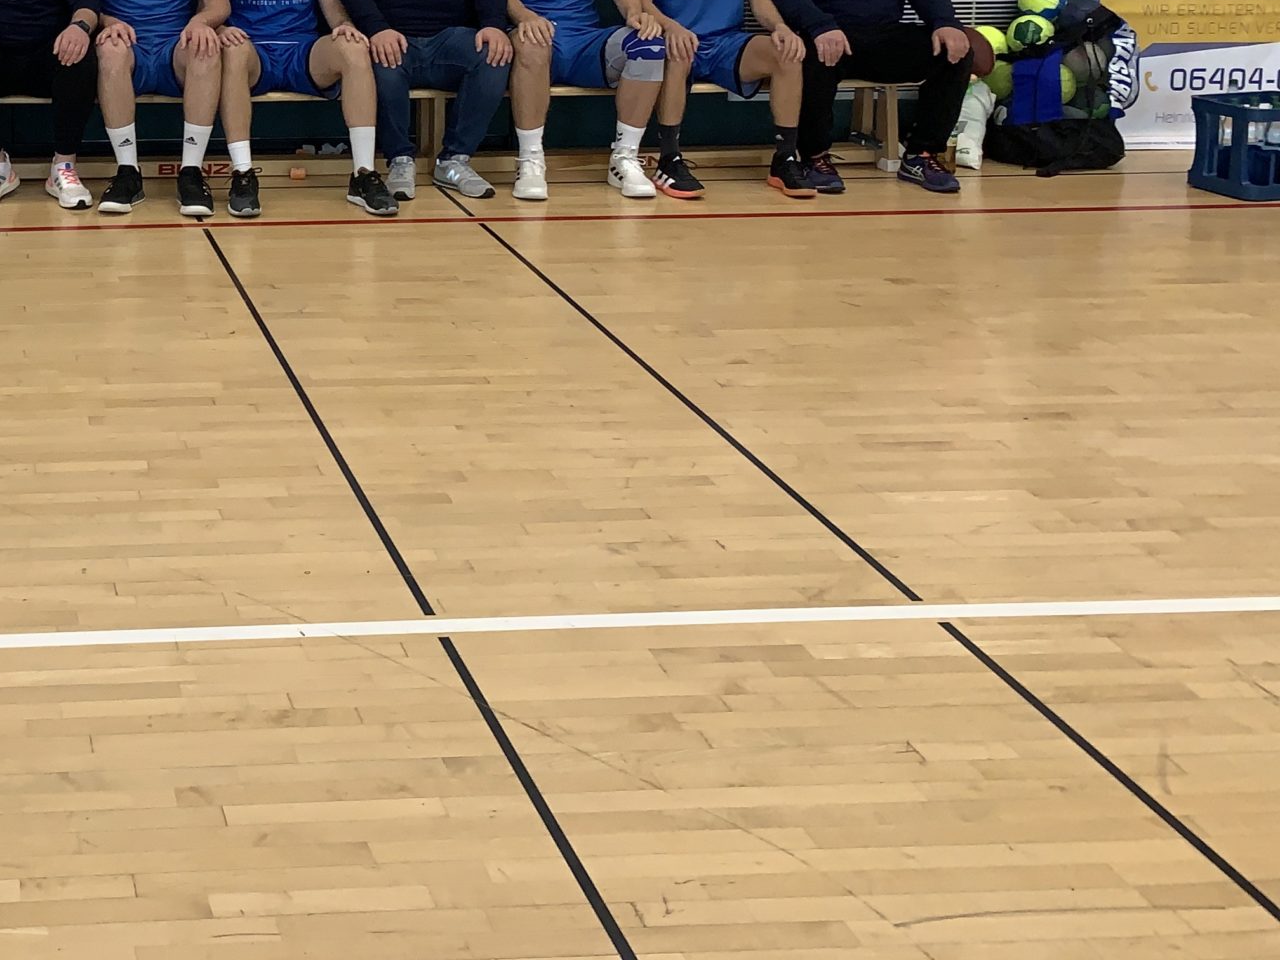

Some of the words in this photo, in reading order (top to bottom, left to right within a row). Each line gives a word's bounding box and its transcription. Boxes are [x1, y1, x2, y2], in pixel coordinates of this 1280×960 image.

[1143, 3, 1169, 17] WIR
[1177, 3, 1266, 17] ERWEITERN
[1146, 21, 1180, 35] UND
[1187, 21, 1250, 35] SUCHEN
[1169, 67, 1280, 91] 06404-
[157, 162, 231, 176] BNZ
